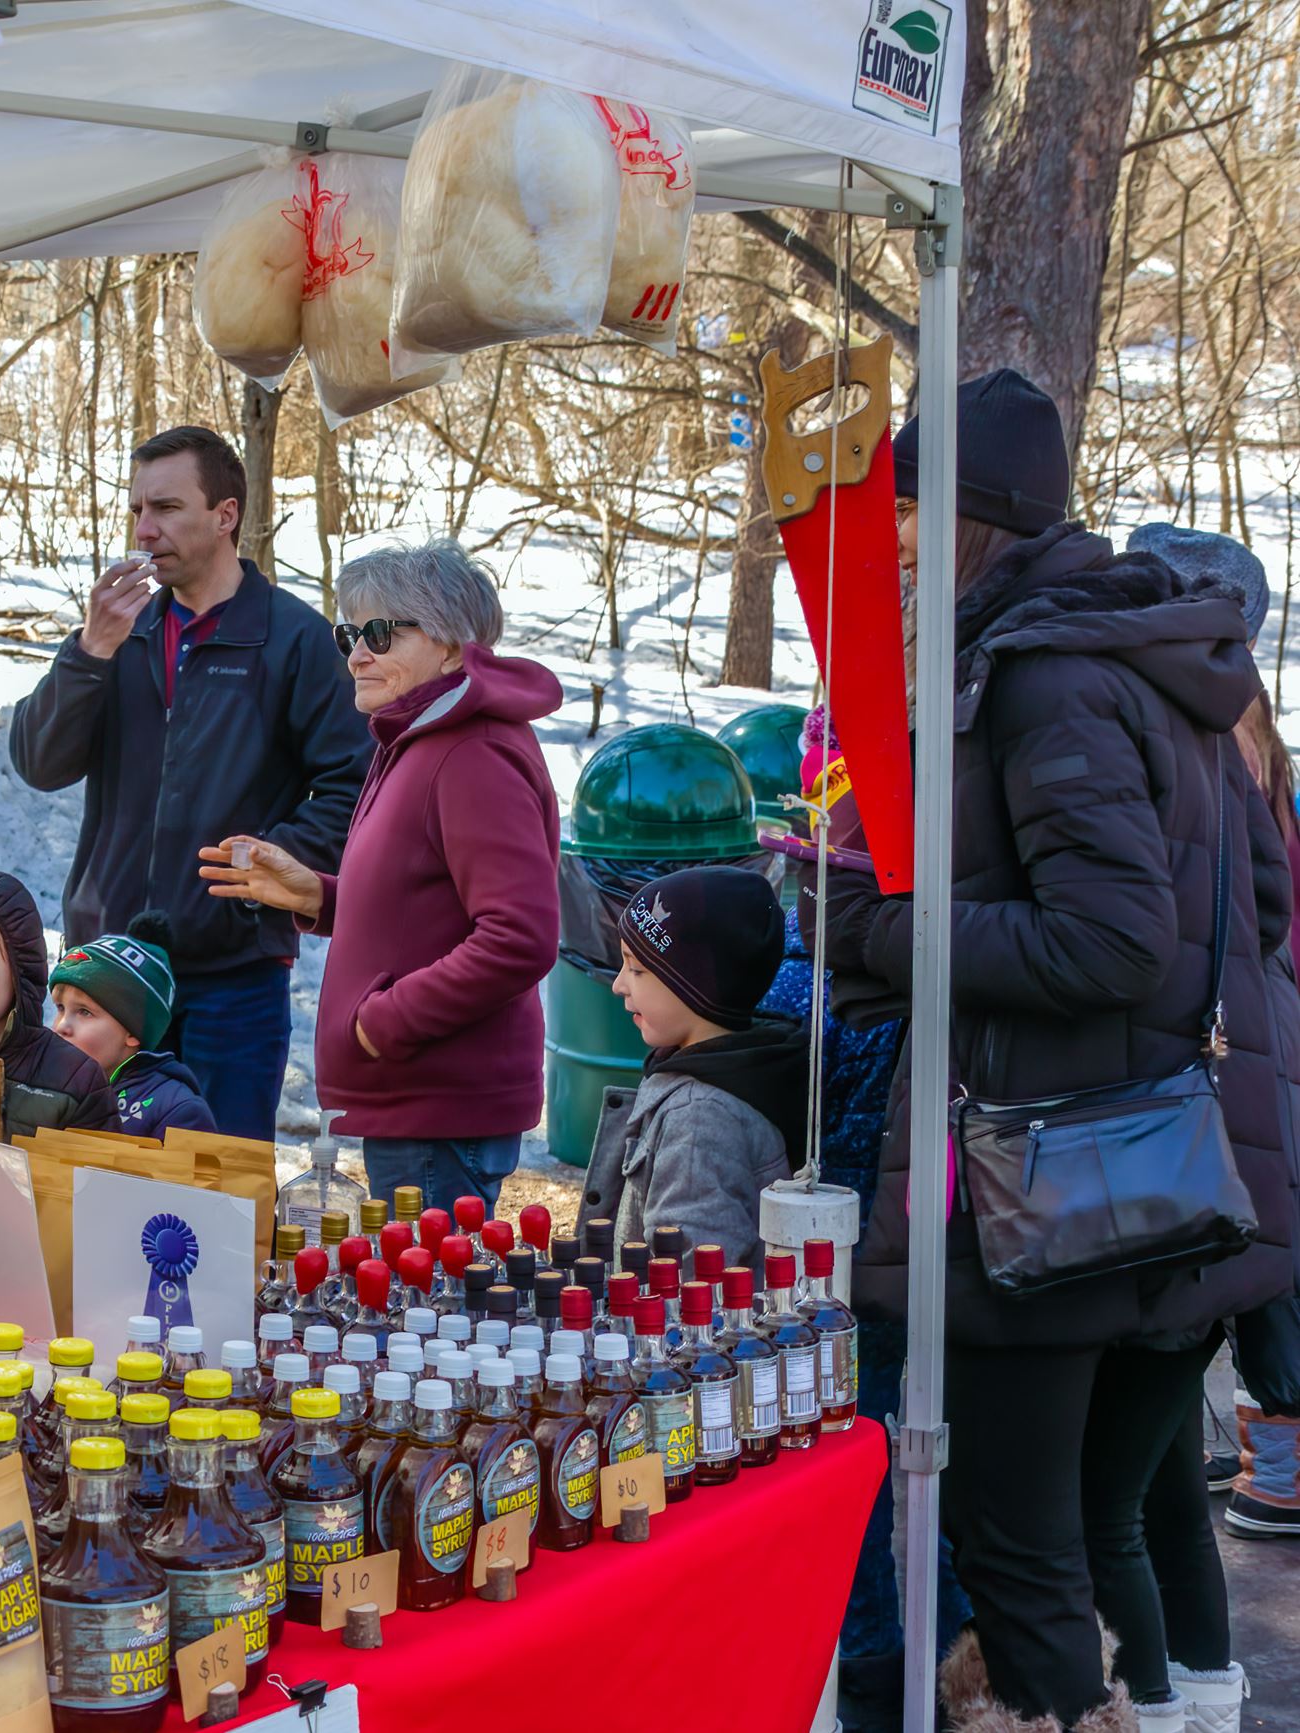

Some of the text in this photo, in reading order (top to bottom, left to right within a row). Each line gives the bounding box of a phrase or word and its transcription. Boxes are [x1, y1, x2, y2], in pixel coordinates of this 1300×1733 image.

[860, 27, 932, 103] Eurmax
[497, 1484, 538, 1515] MAPLE
[432, 1509, 472, 1541] MAPLE
[293, 1535, 364, 1563] MAPLE
[432, 1527, 472, 1559] SYRUP
[486, 1527, 507, 1561] $8
[214, 1606, 268, 1632] MAPL
[110, 1661, 170, 1695] SYRU
[198, 1644, 229, 1686] $18
